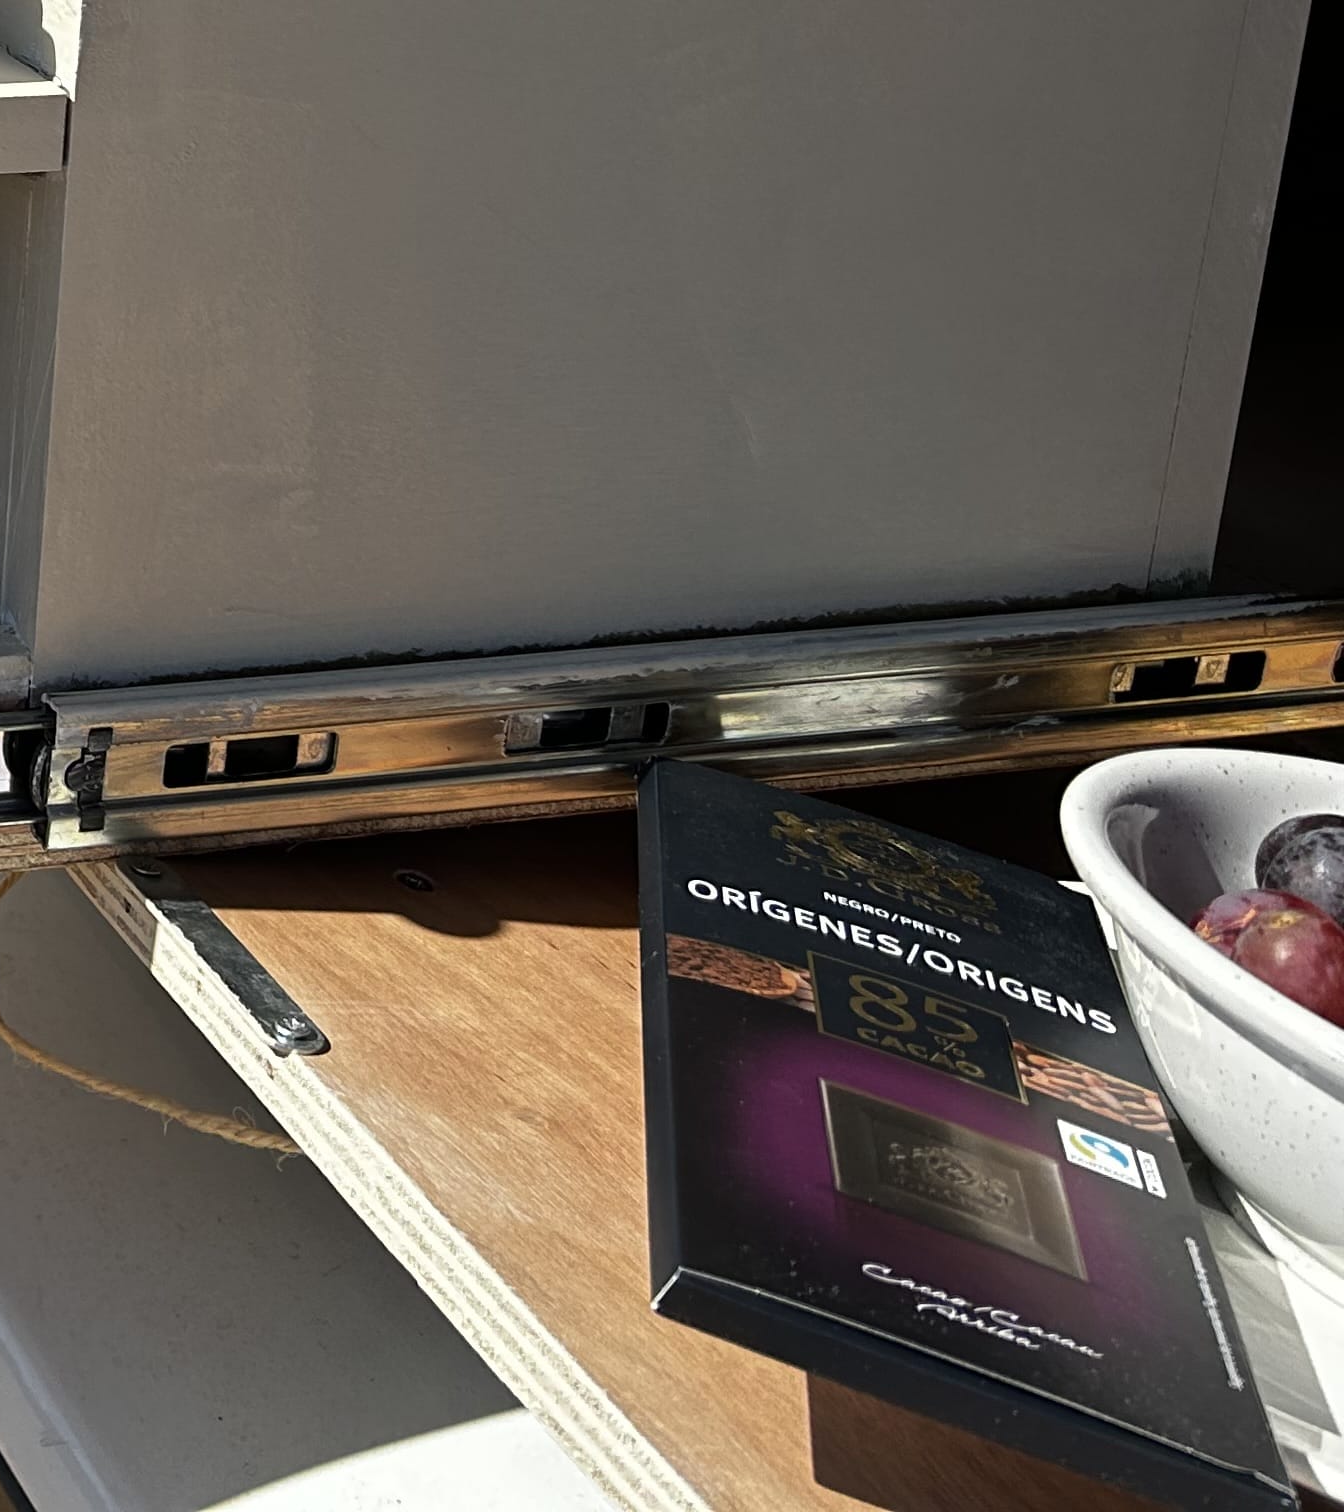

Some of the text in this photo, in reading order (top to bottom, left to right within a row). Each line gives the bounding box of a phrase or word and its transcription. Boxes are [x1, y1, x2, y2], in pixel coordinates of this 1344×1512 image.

[822, 890, 962, 945] NEGRO/PRETO
[848, 973, 979, 1044] 85
[856, 1026, 986, 1079] CACAO
